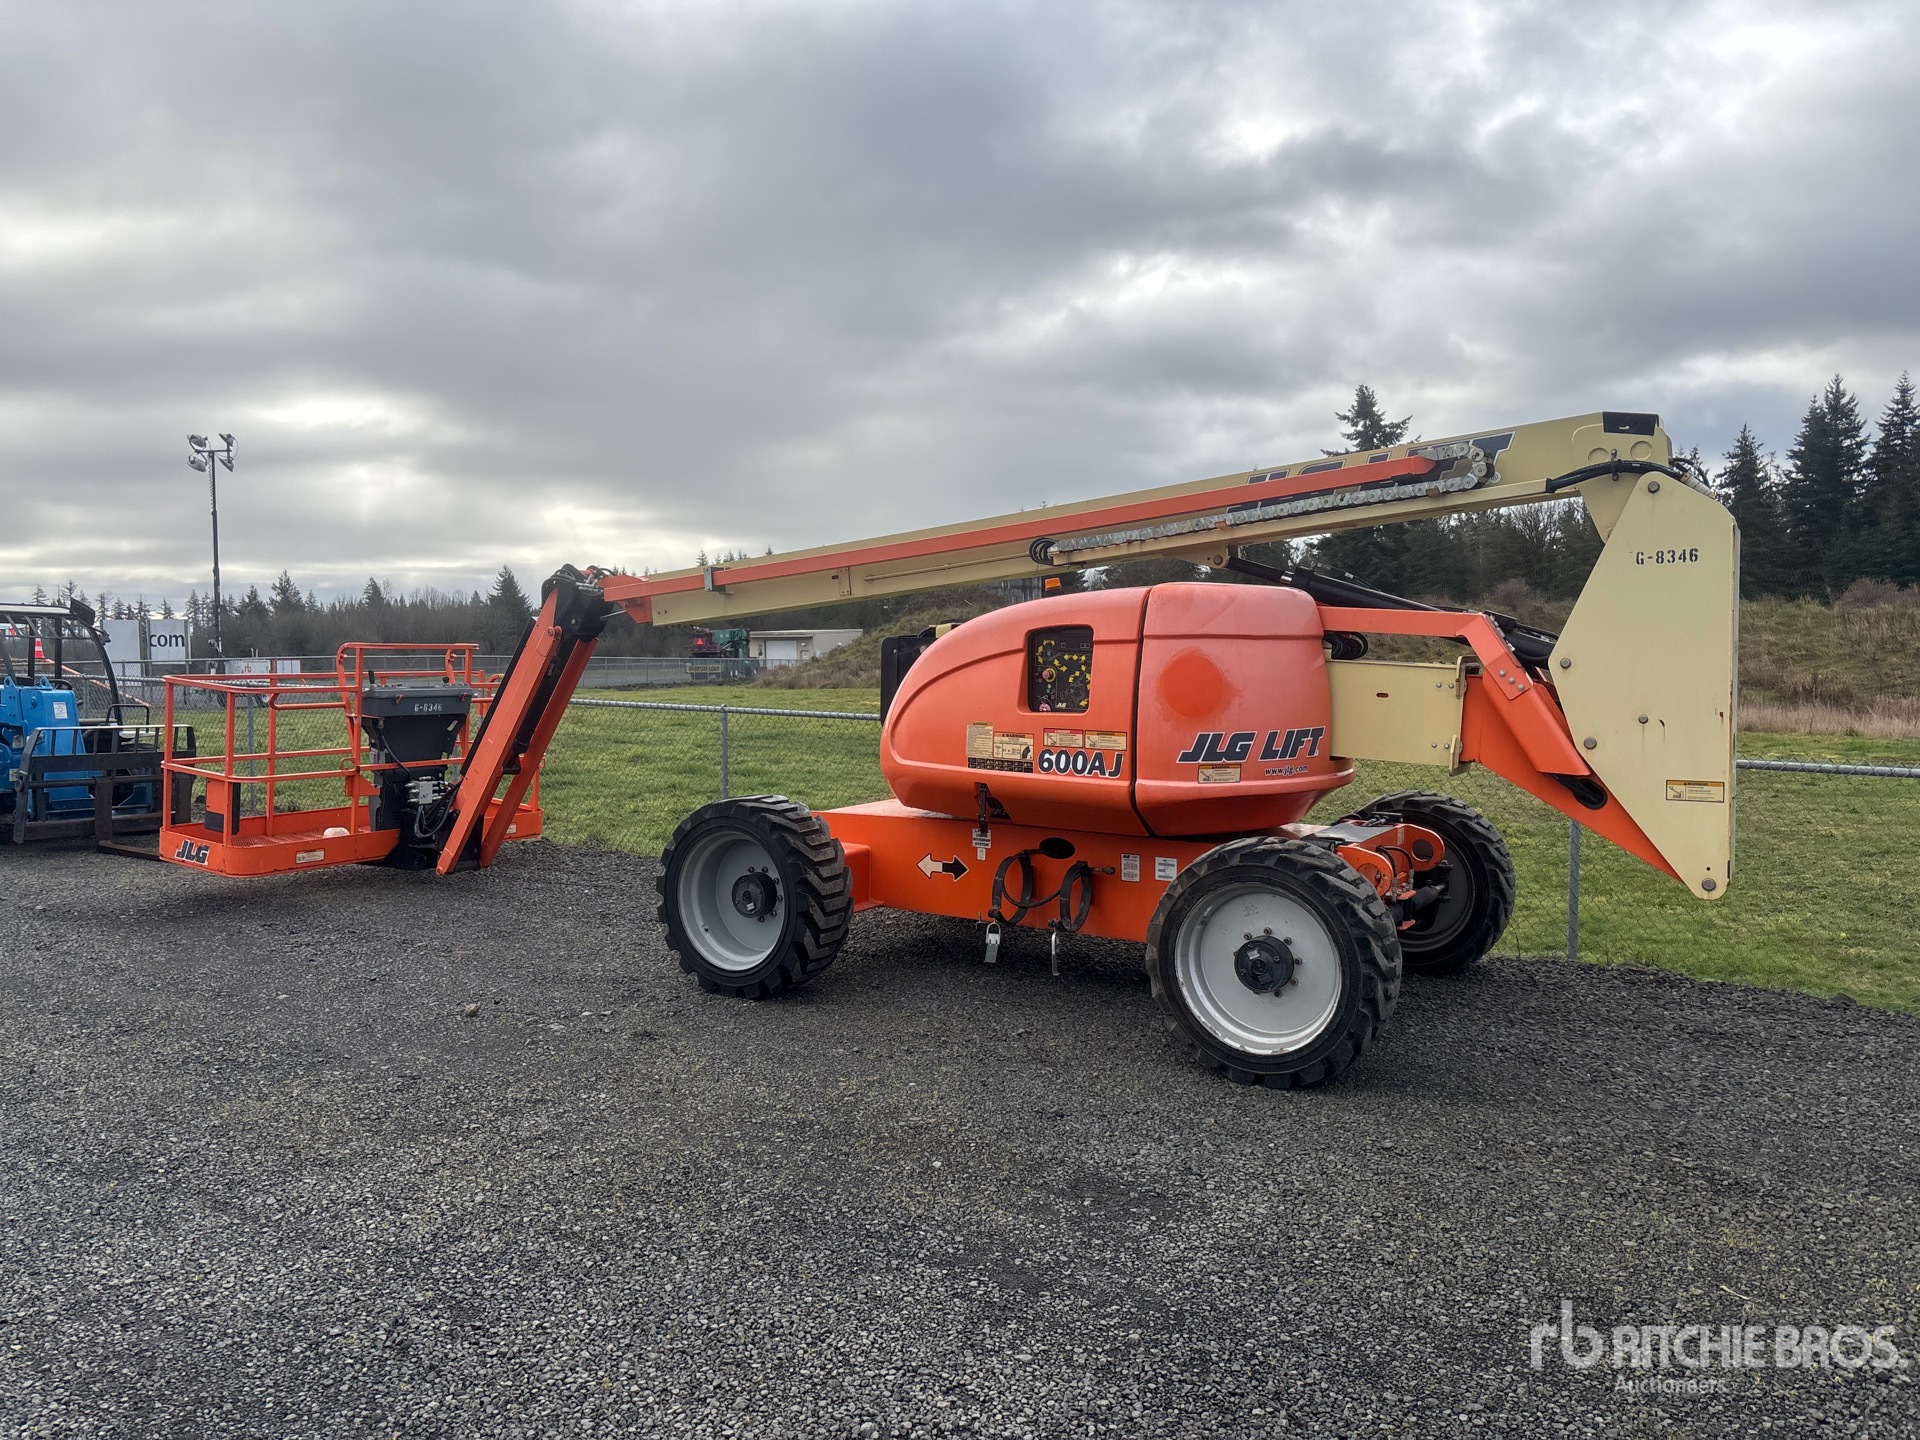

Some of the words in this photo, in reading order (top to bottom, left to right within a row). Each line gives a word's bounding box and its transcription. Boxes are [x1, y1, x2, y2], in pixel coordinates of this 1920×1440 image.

[1635, 547, 1699, 565] G-8346
[1176, 731, 1257, 763] JLG
[1258, 726, 1326, 761] LIFT
[1038, 748, 1123, 778] 600AJ
[1265, 765, 1308, 776] www.jlg.com
[175, 840, 209, 865] JLG
